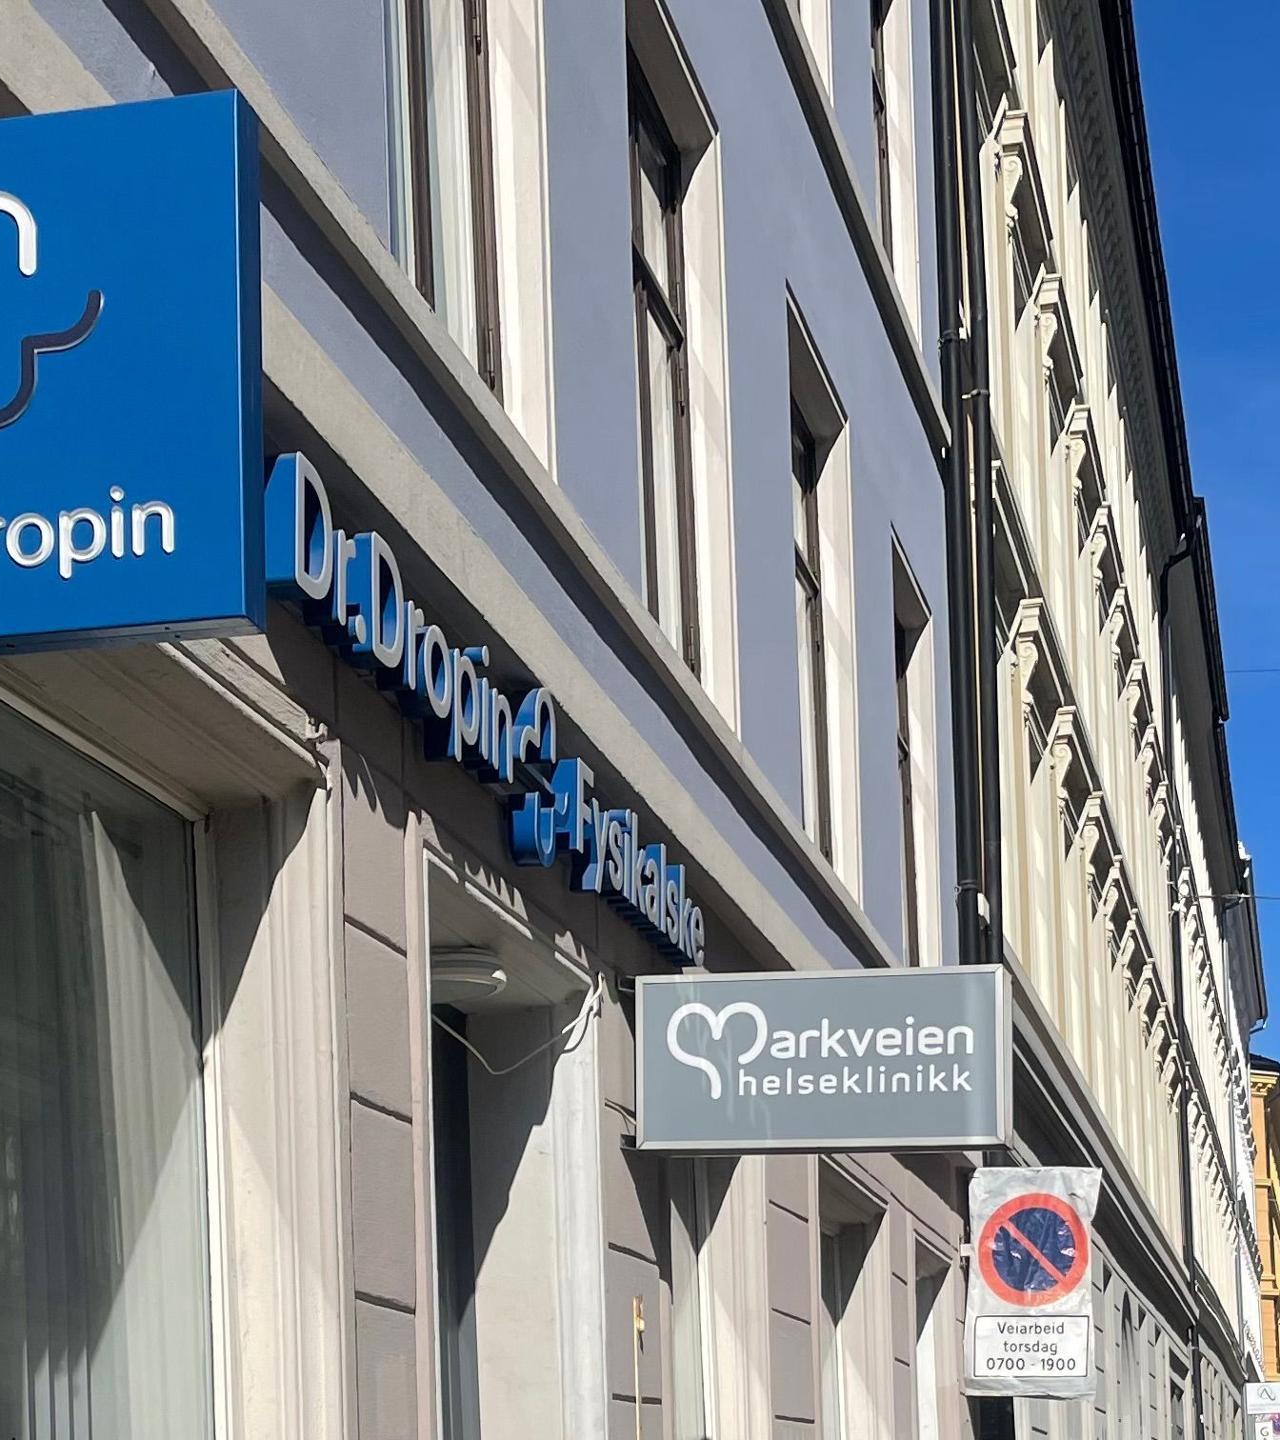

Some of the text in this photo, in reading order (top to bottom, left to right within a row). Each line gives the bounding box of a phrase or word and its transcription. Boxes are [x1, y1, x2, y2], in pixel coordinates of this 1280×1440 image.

[294, 451, 706, 967] Dr.Dropin Fysikalske
[667, 1001, 975, 1100] Markveien
[737, 1063, 973, 1097] helseklinikk
[997, 1321, 1065, 1335] Veiarbeid
[1003, 1340, 1058, 1356] torsdag
[986, 1357, 1026, 1371] 0700
[1040, 1357, 1076, 1371] 1900
